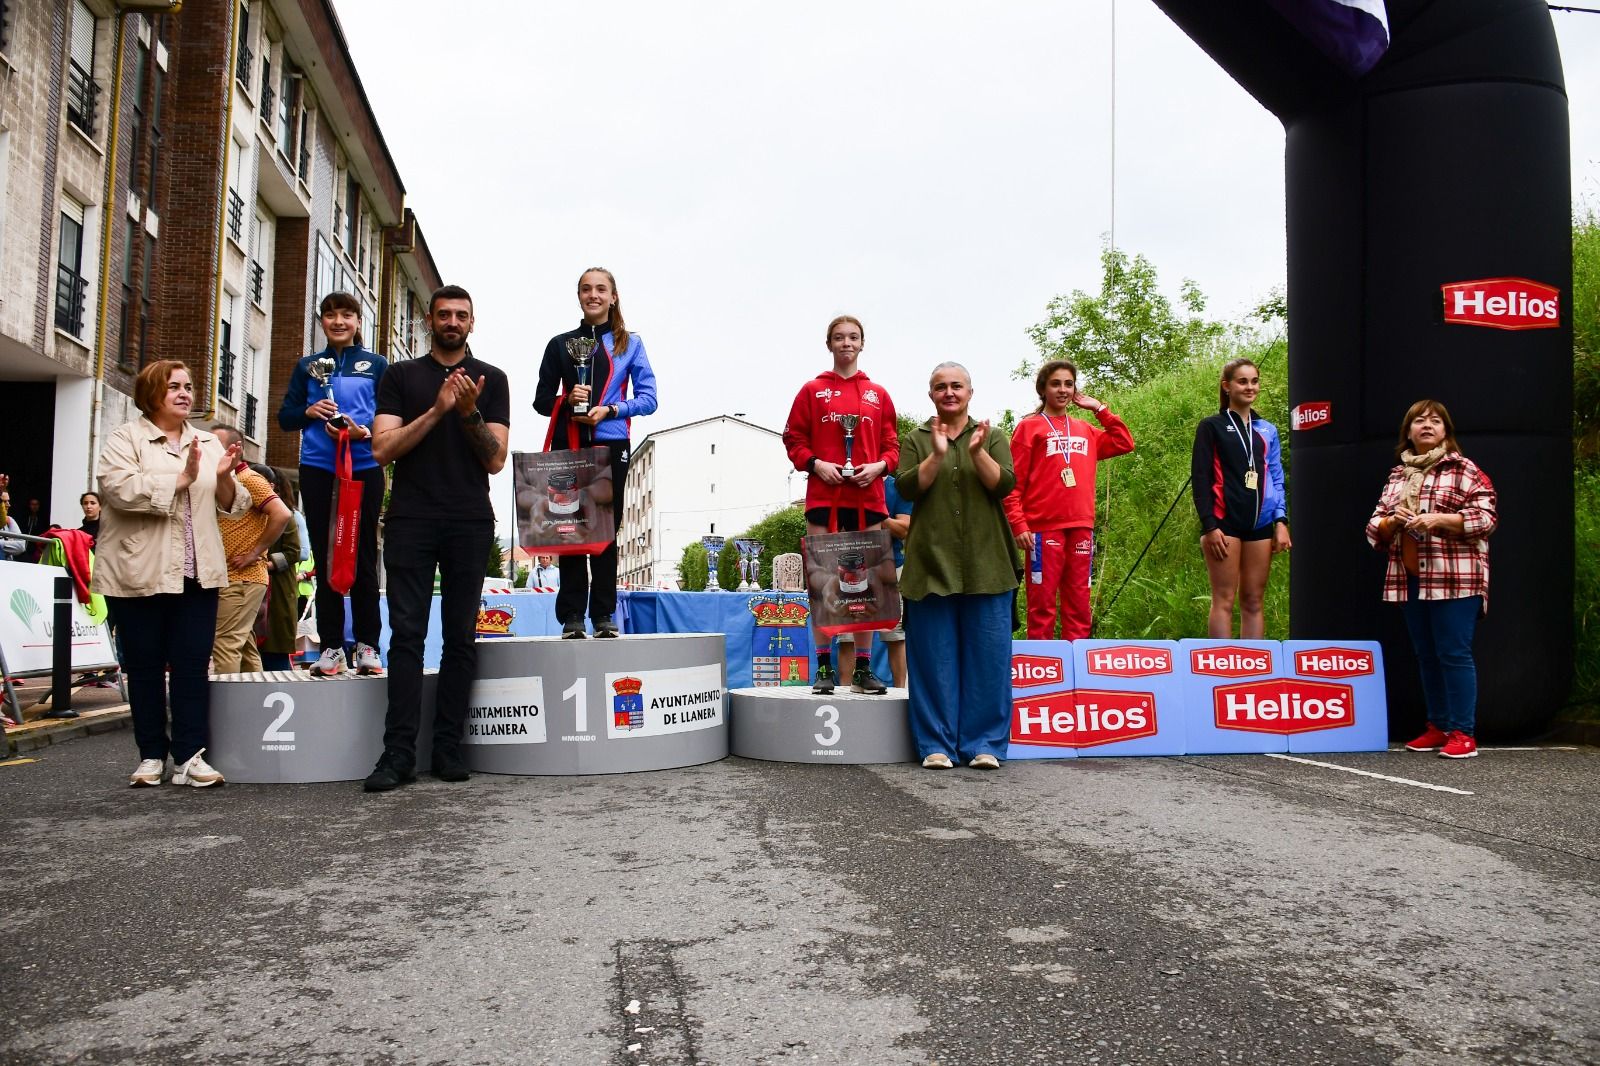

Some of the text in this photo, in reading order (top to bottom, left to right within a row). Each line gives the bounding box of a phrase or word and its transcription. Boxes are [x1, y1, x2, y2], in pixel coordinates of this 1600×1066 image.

[1453, 290, 1557, 319] Helios
[1093, 653, 1168, 670] Helios
[1197, 654, 1268, 670] Helios
[1301, 655, 1369, 671] Helios
[562, 677, 588, 732] 1
[650, 689, 721, 710] AYUNTAMIENTO
[1225, 693, 1346, 721] Helios
[262, 691, 295, 742] 2
[467, 704, 539, 719] YUNTAMIENTO
[663, 707, 717, 725] DE LLANERA
[1018, 703, 1147, 735] Helios
[469, 723, 528, 736] DE LLANERA
[814, 704, 842, 747] 3
